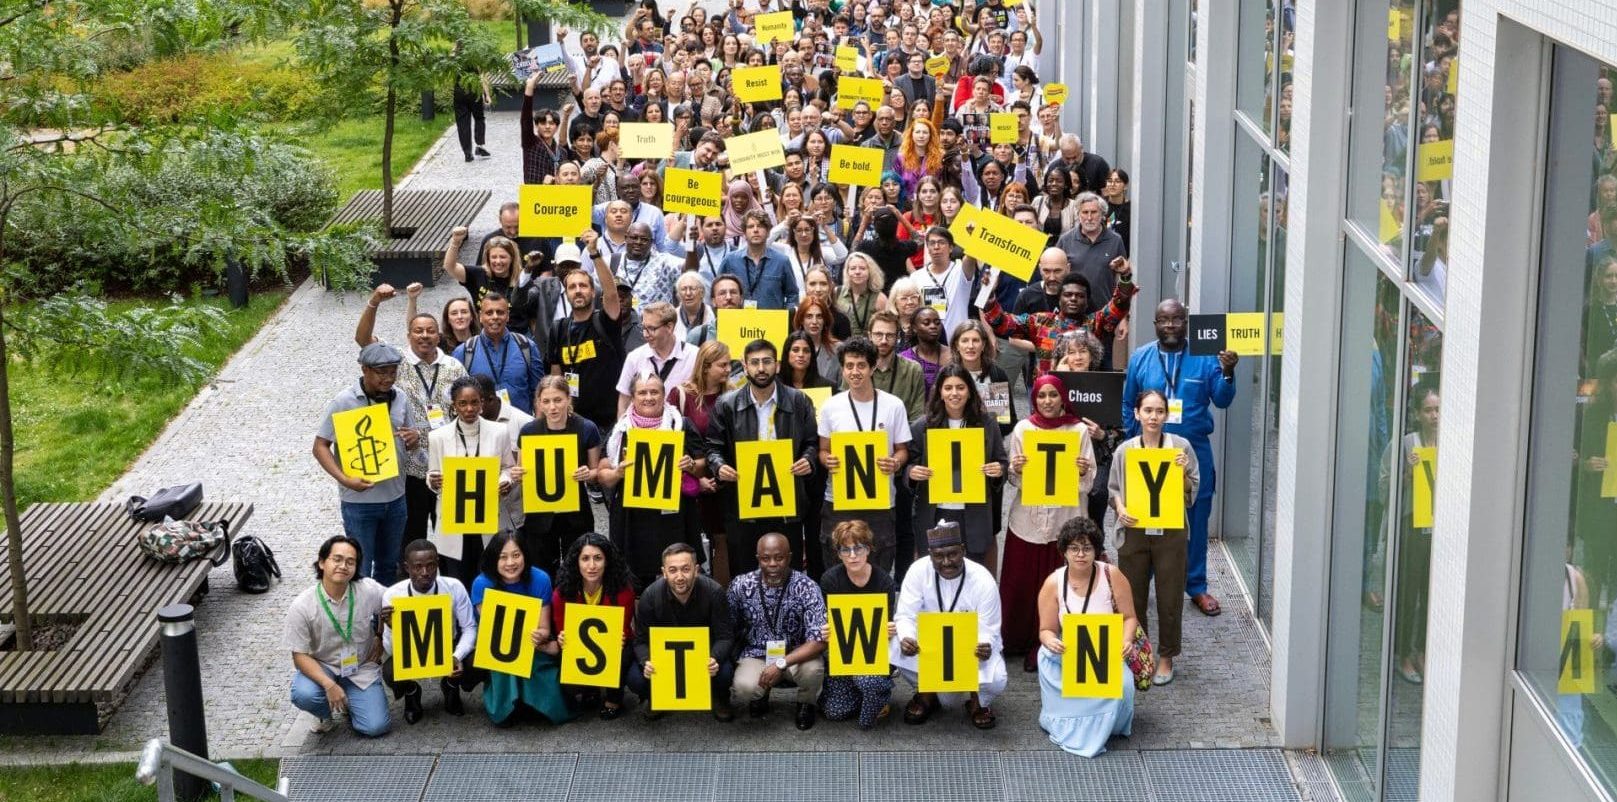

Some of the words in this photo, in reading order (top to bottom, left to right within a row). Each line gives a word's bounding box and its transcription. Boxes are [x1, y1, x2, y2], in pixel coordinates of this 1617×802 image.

[745, 79, 768, 87] Resist
[636, 134, 656, 144] Truth
[839, 159, 851, 169] Be
[852, 160, 872, 172] bold.
[534, 202, 578, 218] Courage
[665, 193, 719, 208] courageous.
[687, 178, 699, 189] Be
[979, 227, 1032, 261] Transform.
[740, 326, 766, 340] Unity
[1197, 328, 1218, 340] LIES
[1230, 328, 1260, 339] TRUTH
[1068, 389, 1103, 403] Chaos
[534, 448, 565, 502] U
[632, 441, 675, 500] M
[751, 453, 783, 508] A
[844, 444, 876, 500] N
[951, 441, 962, 493] I
[1037, 443, 1066, 495] T
[1138, 461, 1170, 517] Y
[455, 469, 485, 523] H
[400, 608, 443, 669] M
[490, 604, 526, 663] U
[575, 618, 609, 676] S
[830, 607, 883, 665] W
[942, 625, 953, 681] I
[1076, 624, 1108, 684] N
[664, 641, 695, 699] T
